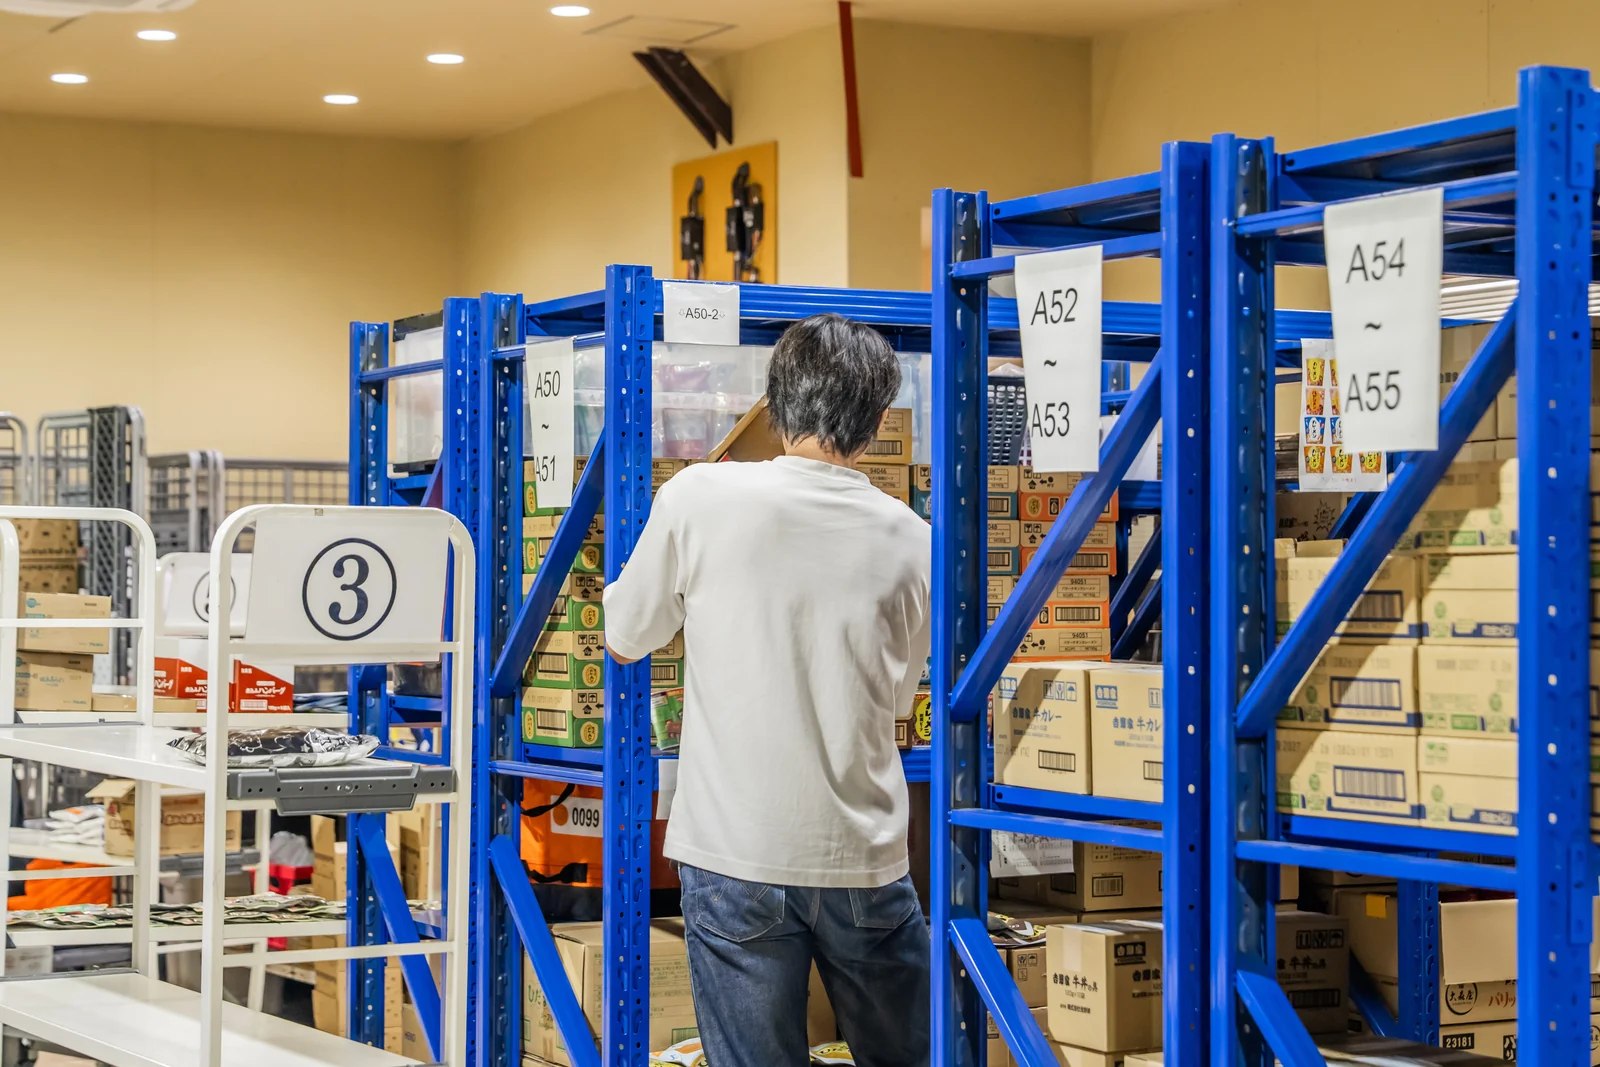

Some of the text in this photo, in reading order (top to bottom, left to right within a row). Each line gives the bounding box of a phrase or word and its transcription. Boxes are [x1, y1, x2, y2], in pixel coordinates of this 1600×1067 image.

[1346, 238, 1406, 284] A54
[685, 307, 719, 320] A50-2
[1030, 287, 1078, 326] A52
[534, 370, 561, 398] A50
[1345, 370, 1402, 413] A55
[1030, 401, 1070, 438] A53
[535, 455, 556, 483] A51
[1033, 706, 1062, 722] 牛カレー
[571, 807, 600, 828] 0099
[1446, 1037, 1472, 1049] 23181
